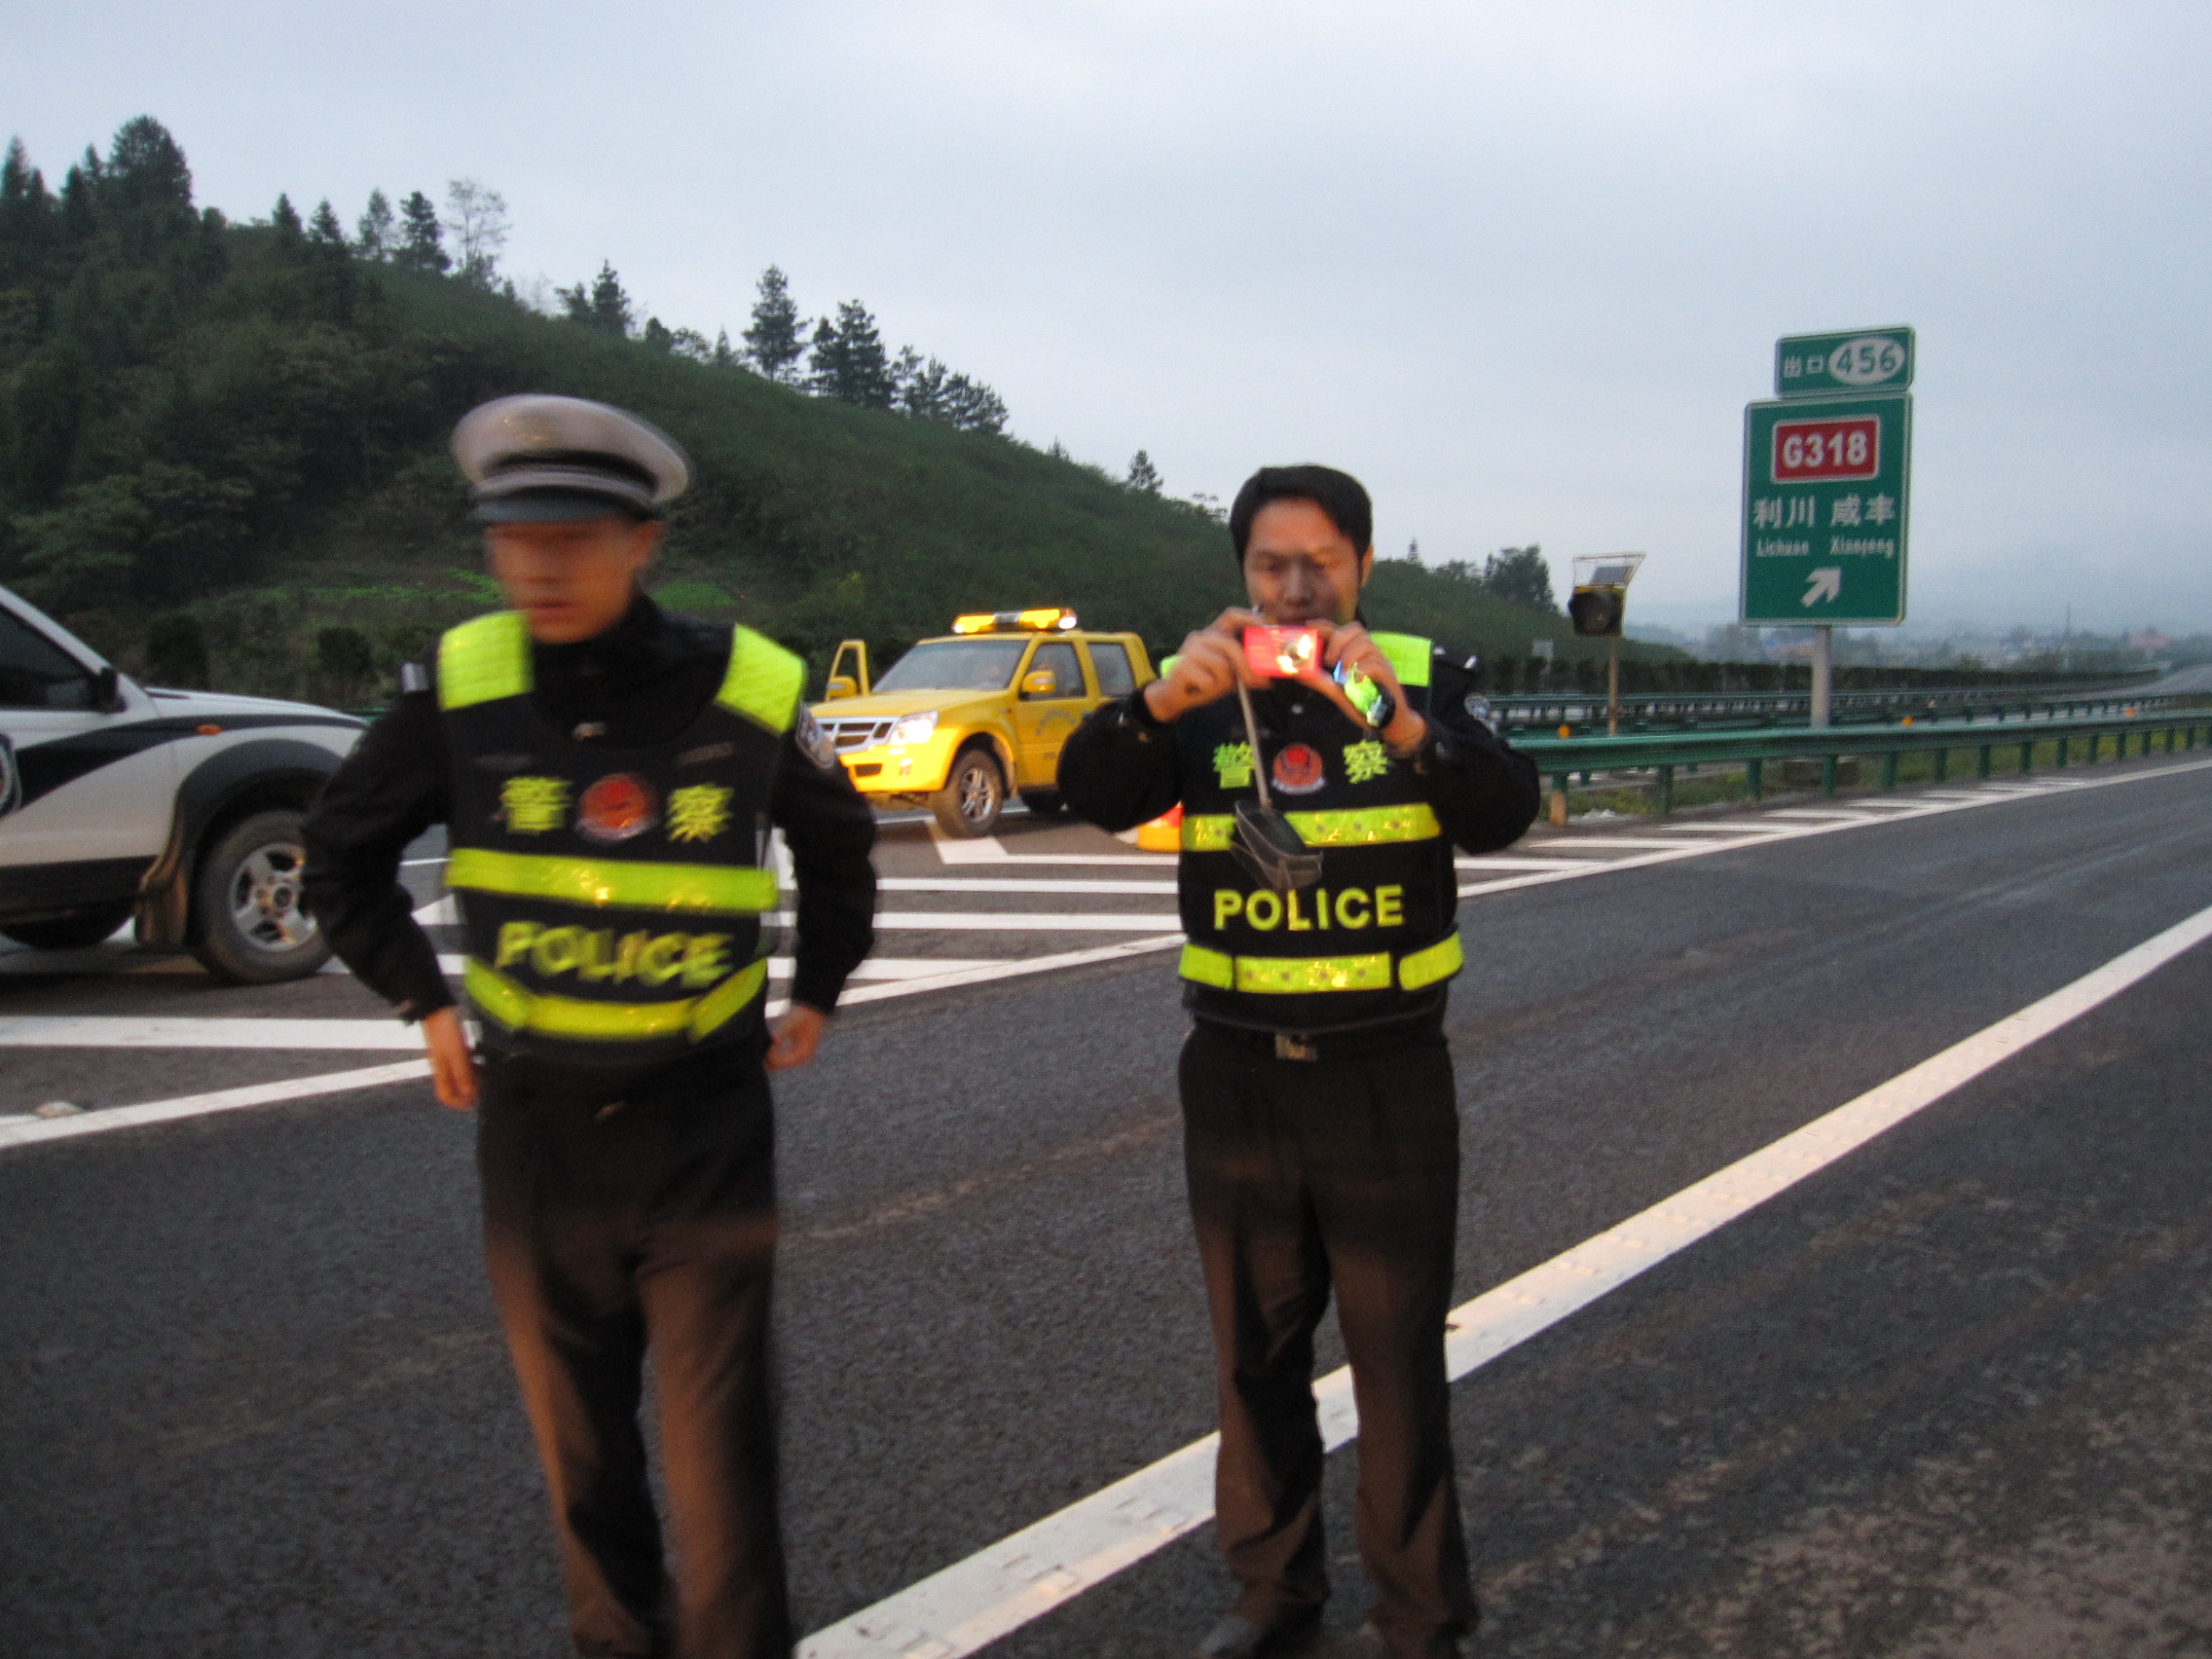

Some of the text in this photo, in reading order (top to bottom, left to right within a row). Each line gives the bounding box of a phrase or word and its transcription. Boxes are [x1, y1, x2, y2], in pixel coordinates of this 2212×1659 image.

[1784, 342, 1898, 378] 出口 456
[1783, 430, 1868, 468] G318
[1753, 496, 1815, 529] 利川
[1213, 883, 1405, 931] POLICE
[494, 920, 734, 988] POLICE
